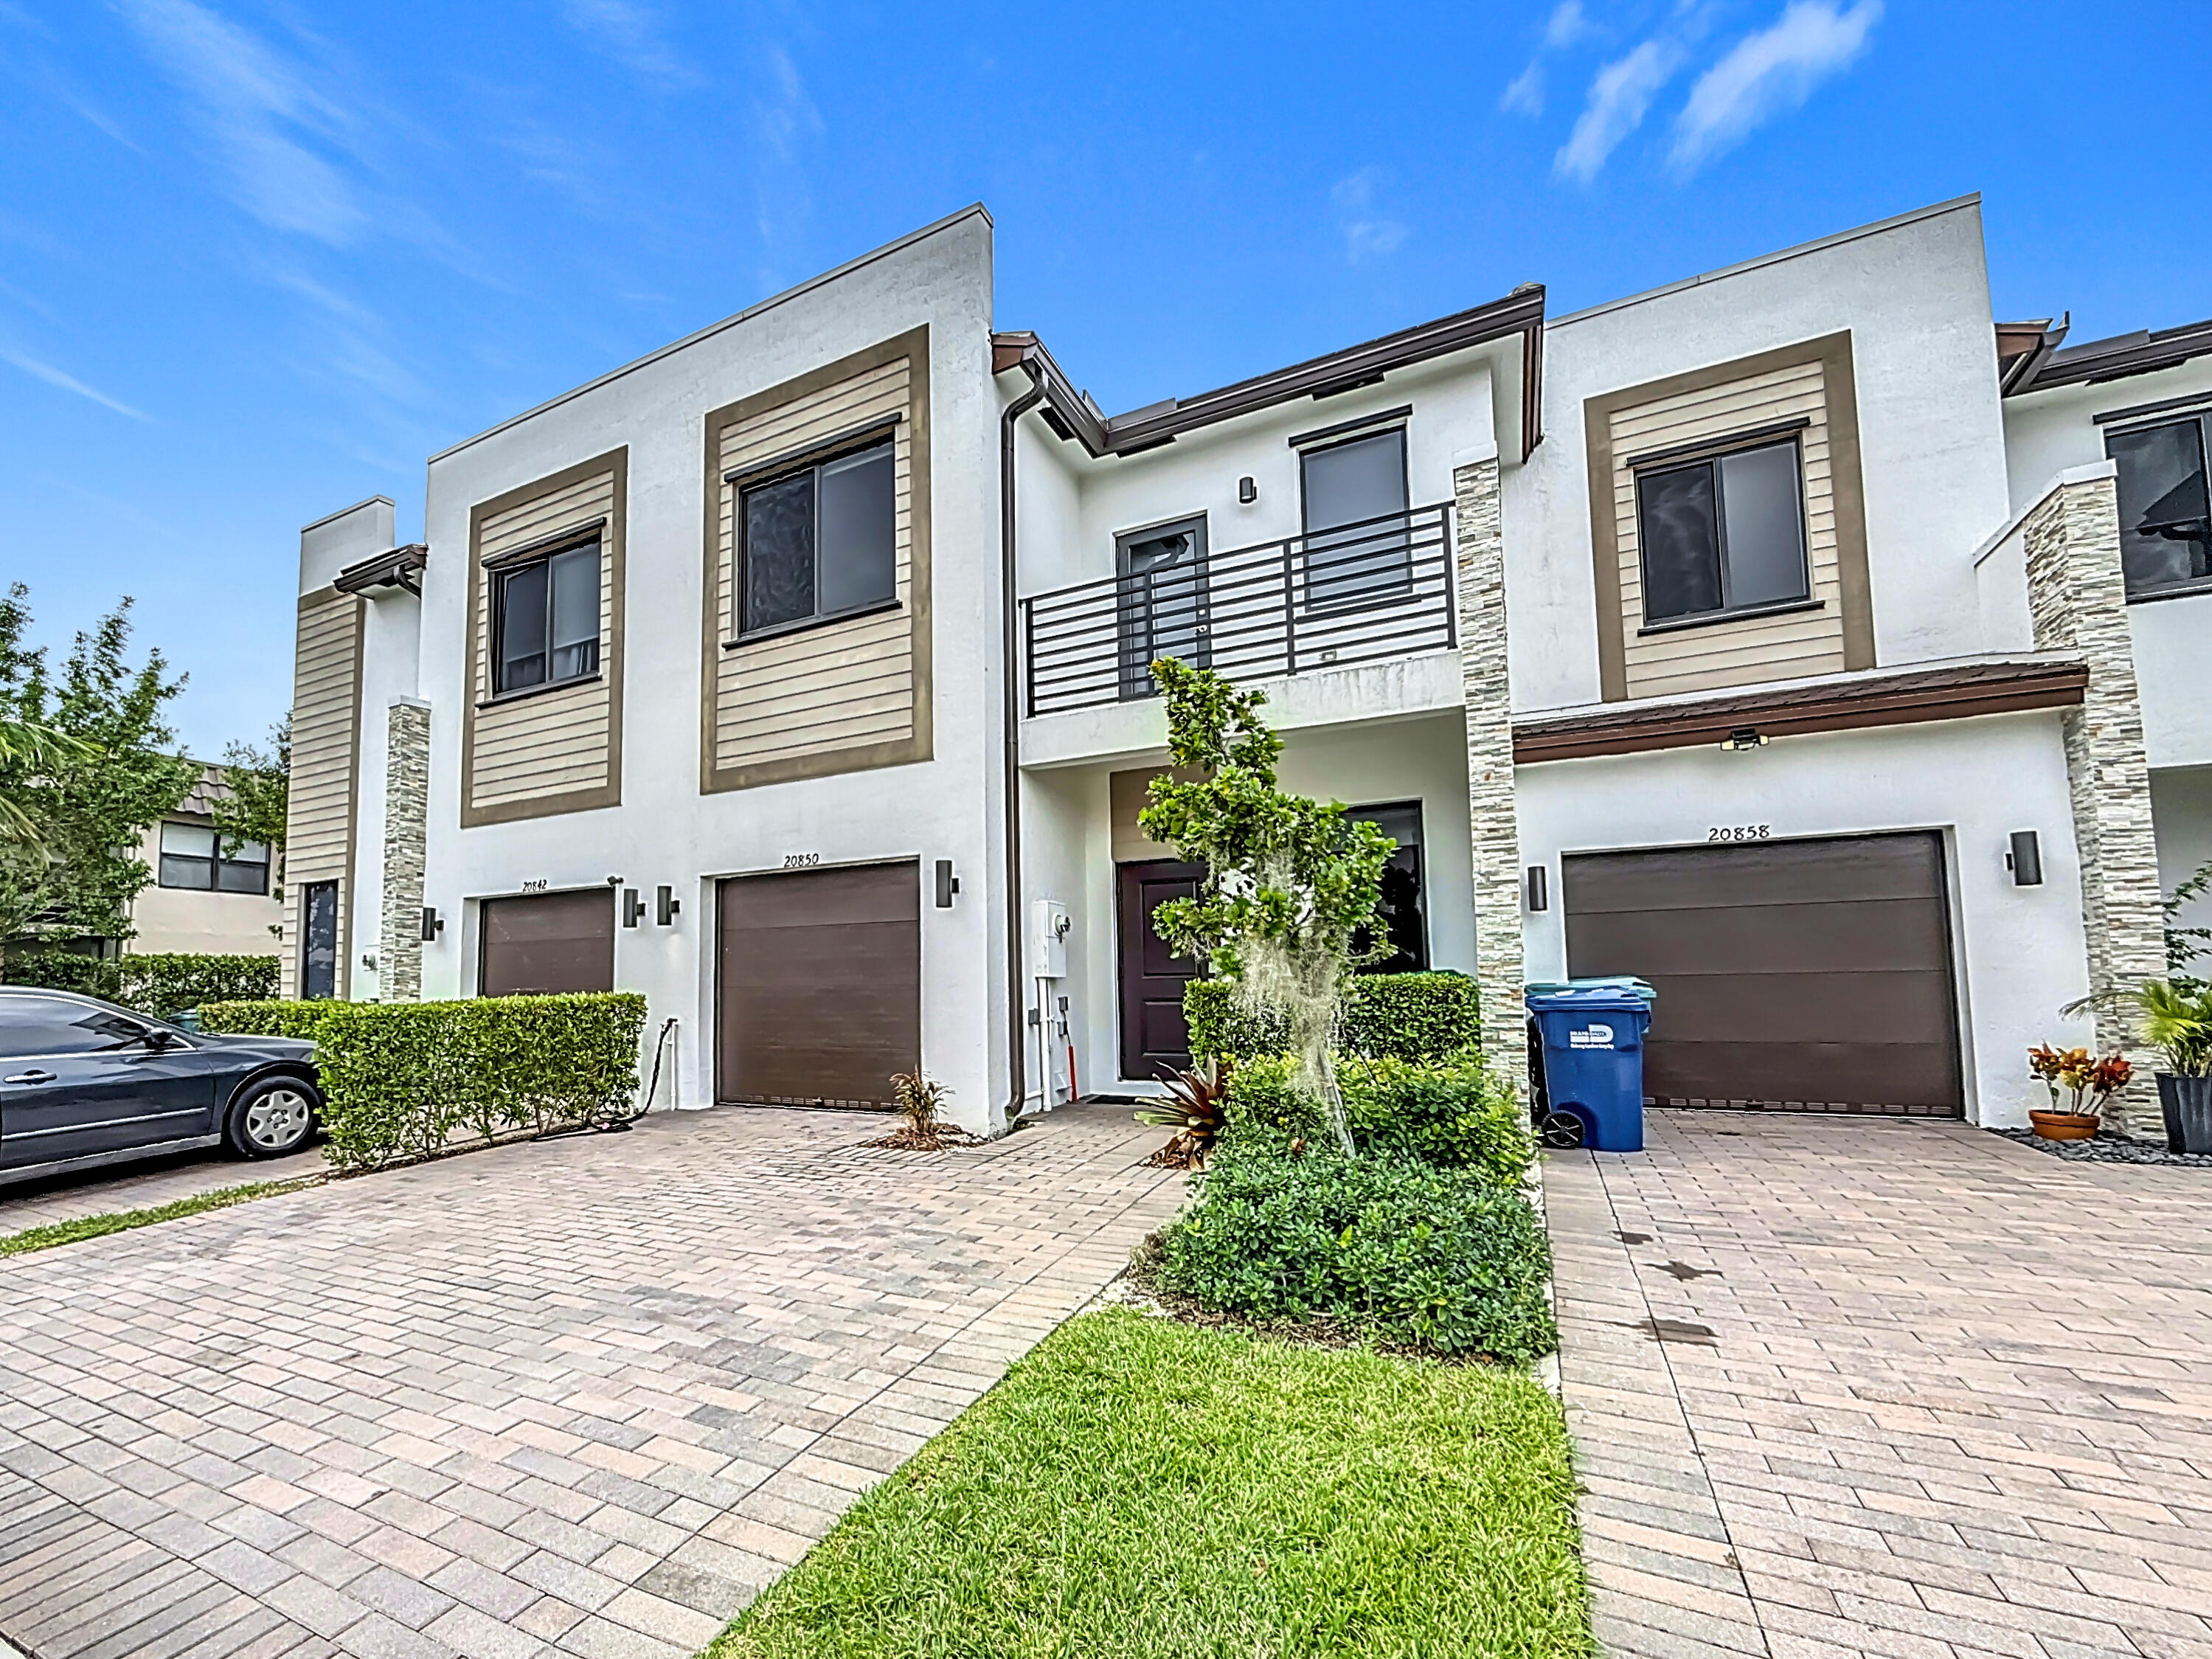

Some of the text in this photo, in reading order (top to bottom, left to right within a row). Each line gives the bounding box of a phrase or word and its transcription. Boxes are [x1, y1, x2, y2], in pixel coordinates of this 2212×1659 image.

[1709, 825, 1769, 841] 20858
[784, 853, 819, 867] 20850
[523, 879, 547, 892] 20842
